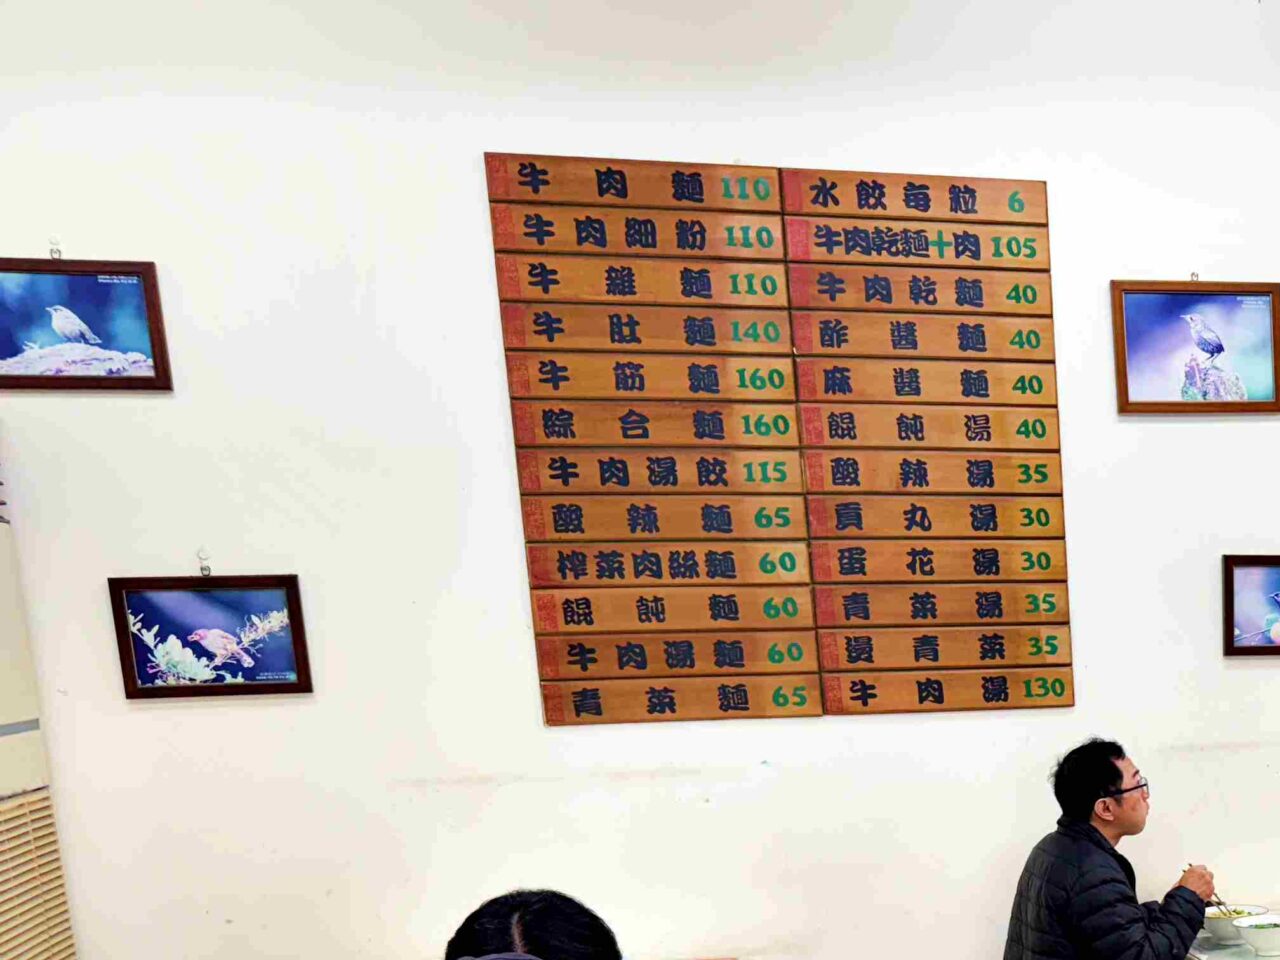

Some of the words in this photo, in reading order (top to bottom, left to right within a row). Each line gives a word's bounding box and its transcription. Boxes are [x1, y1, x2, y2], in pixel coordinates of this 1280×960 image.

[518, 163, 704, 201] 牛肉麵
[720, 176, 770, 201] 110
[811, 179, 977, 214] 水餃每粒
[1008, 190, 1024, 214] 6
[523, 214, 706, 249] 牛肉細粉
[724, 225, 774, 249] 110
[990, 234, 1038, 259] 105
[528, 264, 711, 298] 牛雜麵
[729, 273, 778, 296] 110
[818, 273, 983, 307] 牛肉乾麵
[1005, 284, 1038, 307] 40
[534, 313, 715, 345] 牛肚麵
[731, 321, 781, 343] 140
[1009, 329, 1041, 350] 40
[539, 361, 719, 393] 牛筋麵
[736, 368, 785, 391] 160
[825, 367, 989, 396] 麻醬麵
[1011, 374, 1043, 396] 40
[543, 409, 724, 439] 綜合麵
[741, 414, 791, 436] 160
[829, 412, 992, 442] 餛飩湯
[1015, 417, 1047, 439] 40
[548, 458, 727, 487] 牛肉湯餃
[743, 461, 787, 483] 115
[832, 459, 995, 487] 酸辣湯
[1017, 463, 1049, 484] 35
[554, 504, 732, 535] 酸辣麵
[753, 507, 791, 529] 65
[835, 503, 997, 532] 貢丸湯
[1019, 507, 1051, 529] 30
[758, 552, 797, 575] 60
[839, 548, 999, 576] 蛋花湯
[1020, 550, 1052, 572] 30
[563, 595, 739, 627] 餛飩麵
[762, 597, 799, 620] 60
[842, 592, 1002, 620] 青菜湯
[1025, 593, 1057, 615] 35
[568, 640, 745, 671] 牛肉湯麵
[767, 643, 804, 665] 60
[846, 634, 1005, 663] 燙青菜
[1027, 635, 1059, 657] 35
[573, 684, 750, 718] 青菜麵
[772, 686, 808, 708] 65
[849, 677, 1009, 707] 牛肉湯
[1023, 677, 1066, 699] 130
